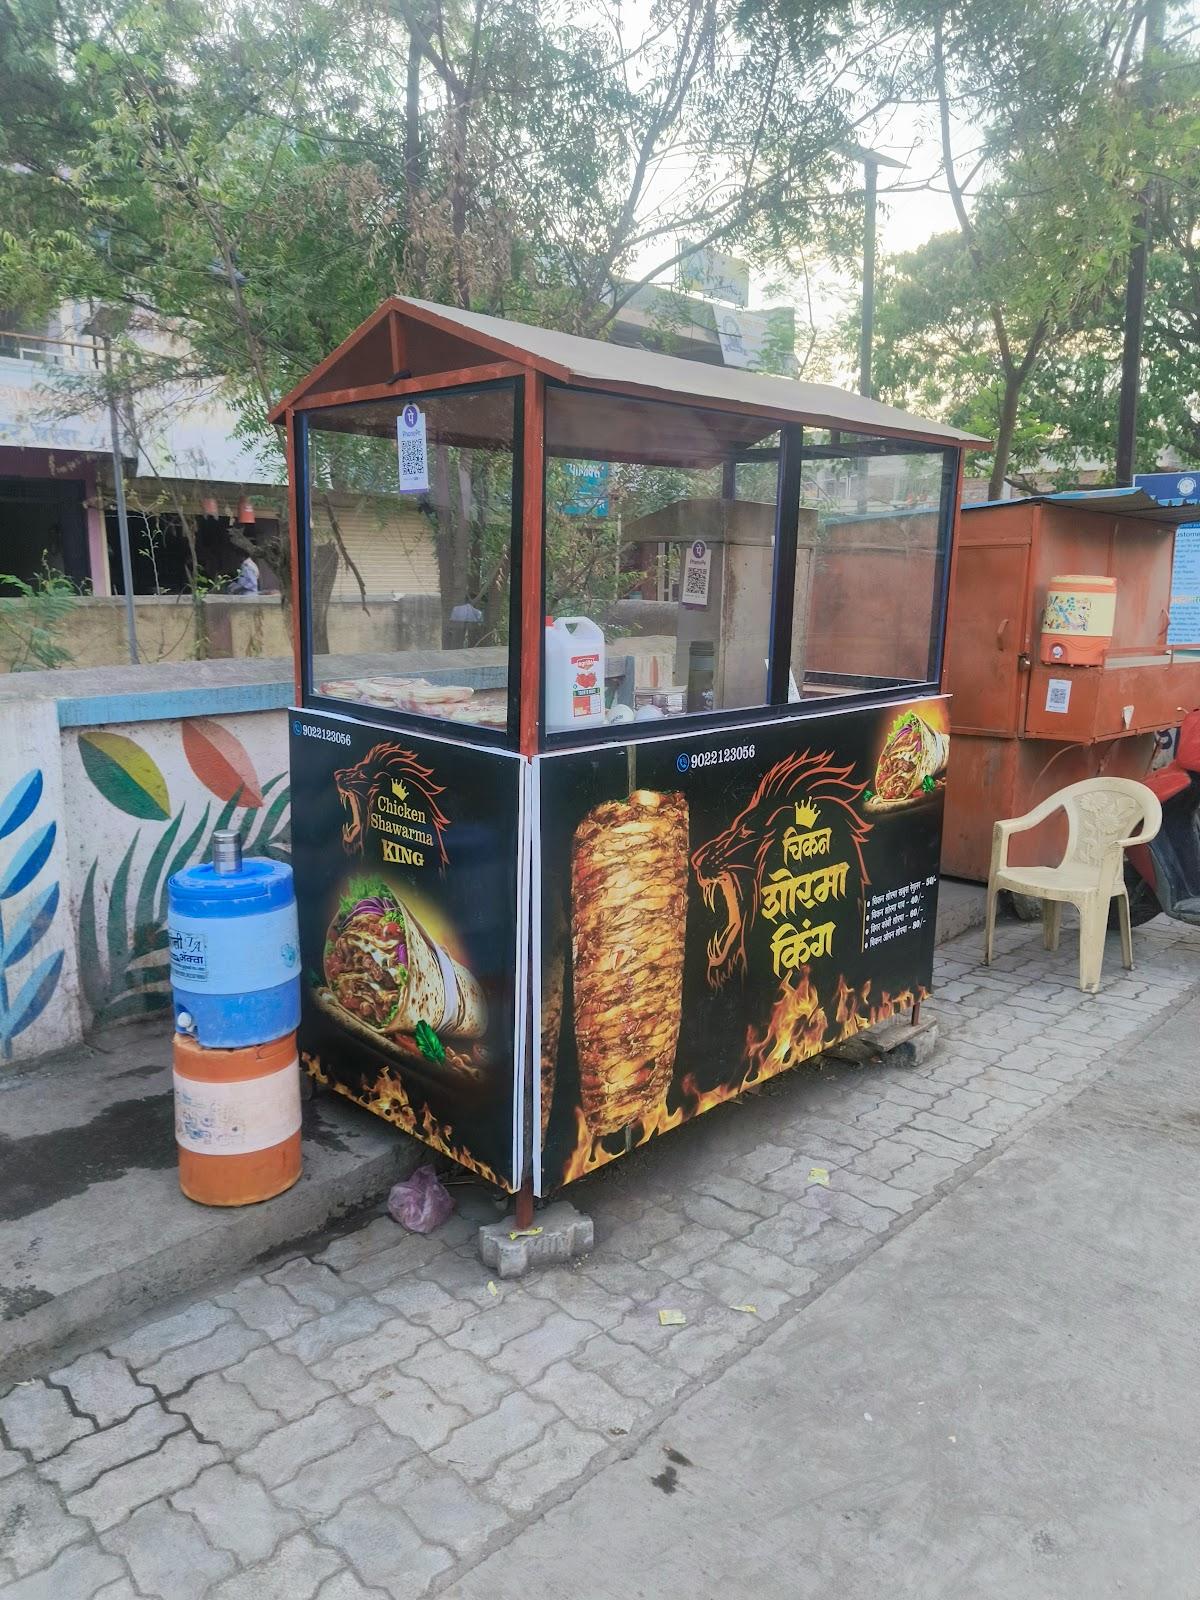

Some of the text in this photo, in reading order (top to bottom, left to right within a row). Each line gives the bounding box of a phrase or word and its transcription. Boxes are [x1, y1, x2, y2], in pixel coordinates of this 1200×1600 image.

[302, 724, 352, 746] 9022123056
[690, 744, 756, 769] 9022123056
[377, 795, 427, 824] Chicken
[370, 813, 434, 847] Shawarma
[381, 838, 425, 867] KING
[782, 826, 832, 866] चिकन
[761, 861, 850, 925] शोरमा
[770, 918, 837, 979] किंग
